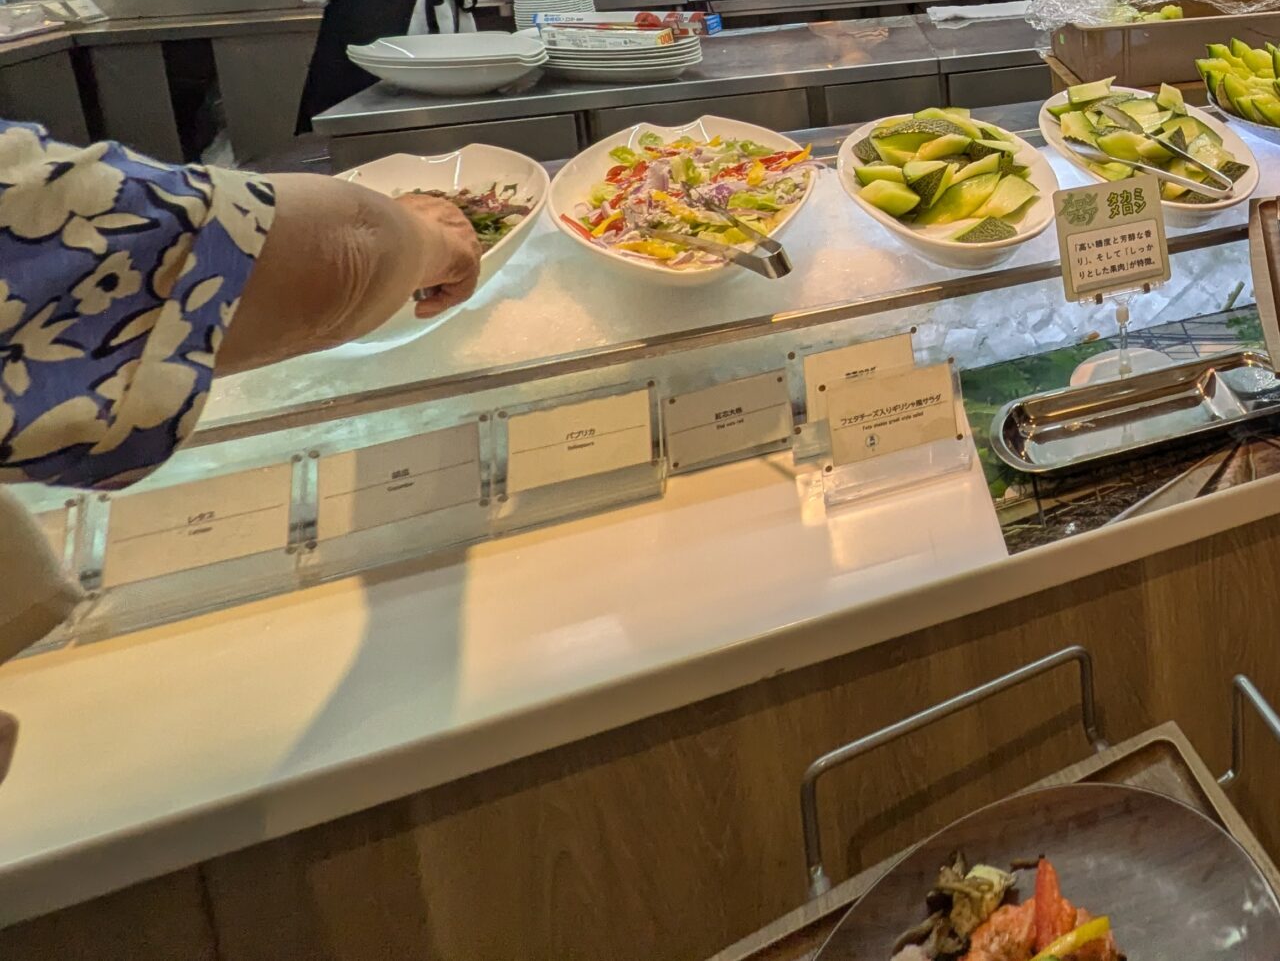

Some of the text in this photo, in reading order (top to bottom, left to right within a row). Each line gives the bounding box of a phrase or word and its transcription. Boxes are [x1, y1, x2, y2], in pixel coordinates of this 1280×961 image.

[1107, 187, 1144, 207] タカミ
[1109, 200, 1147, 219] メロン
